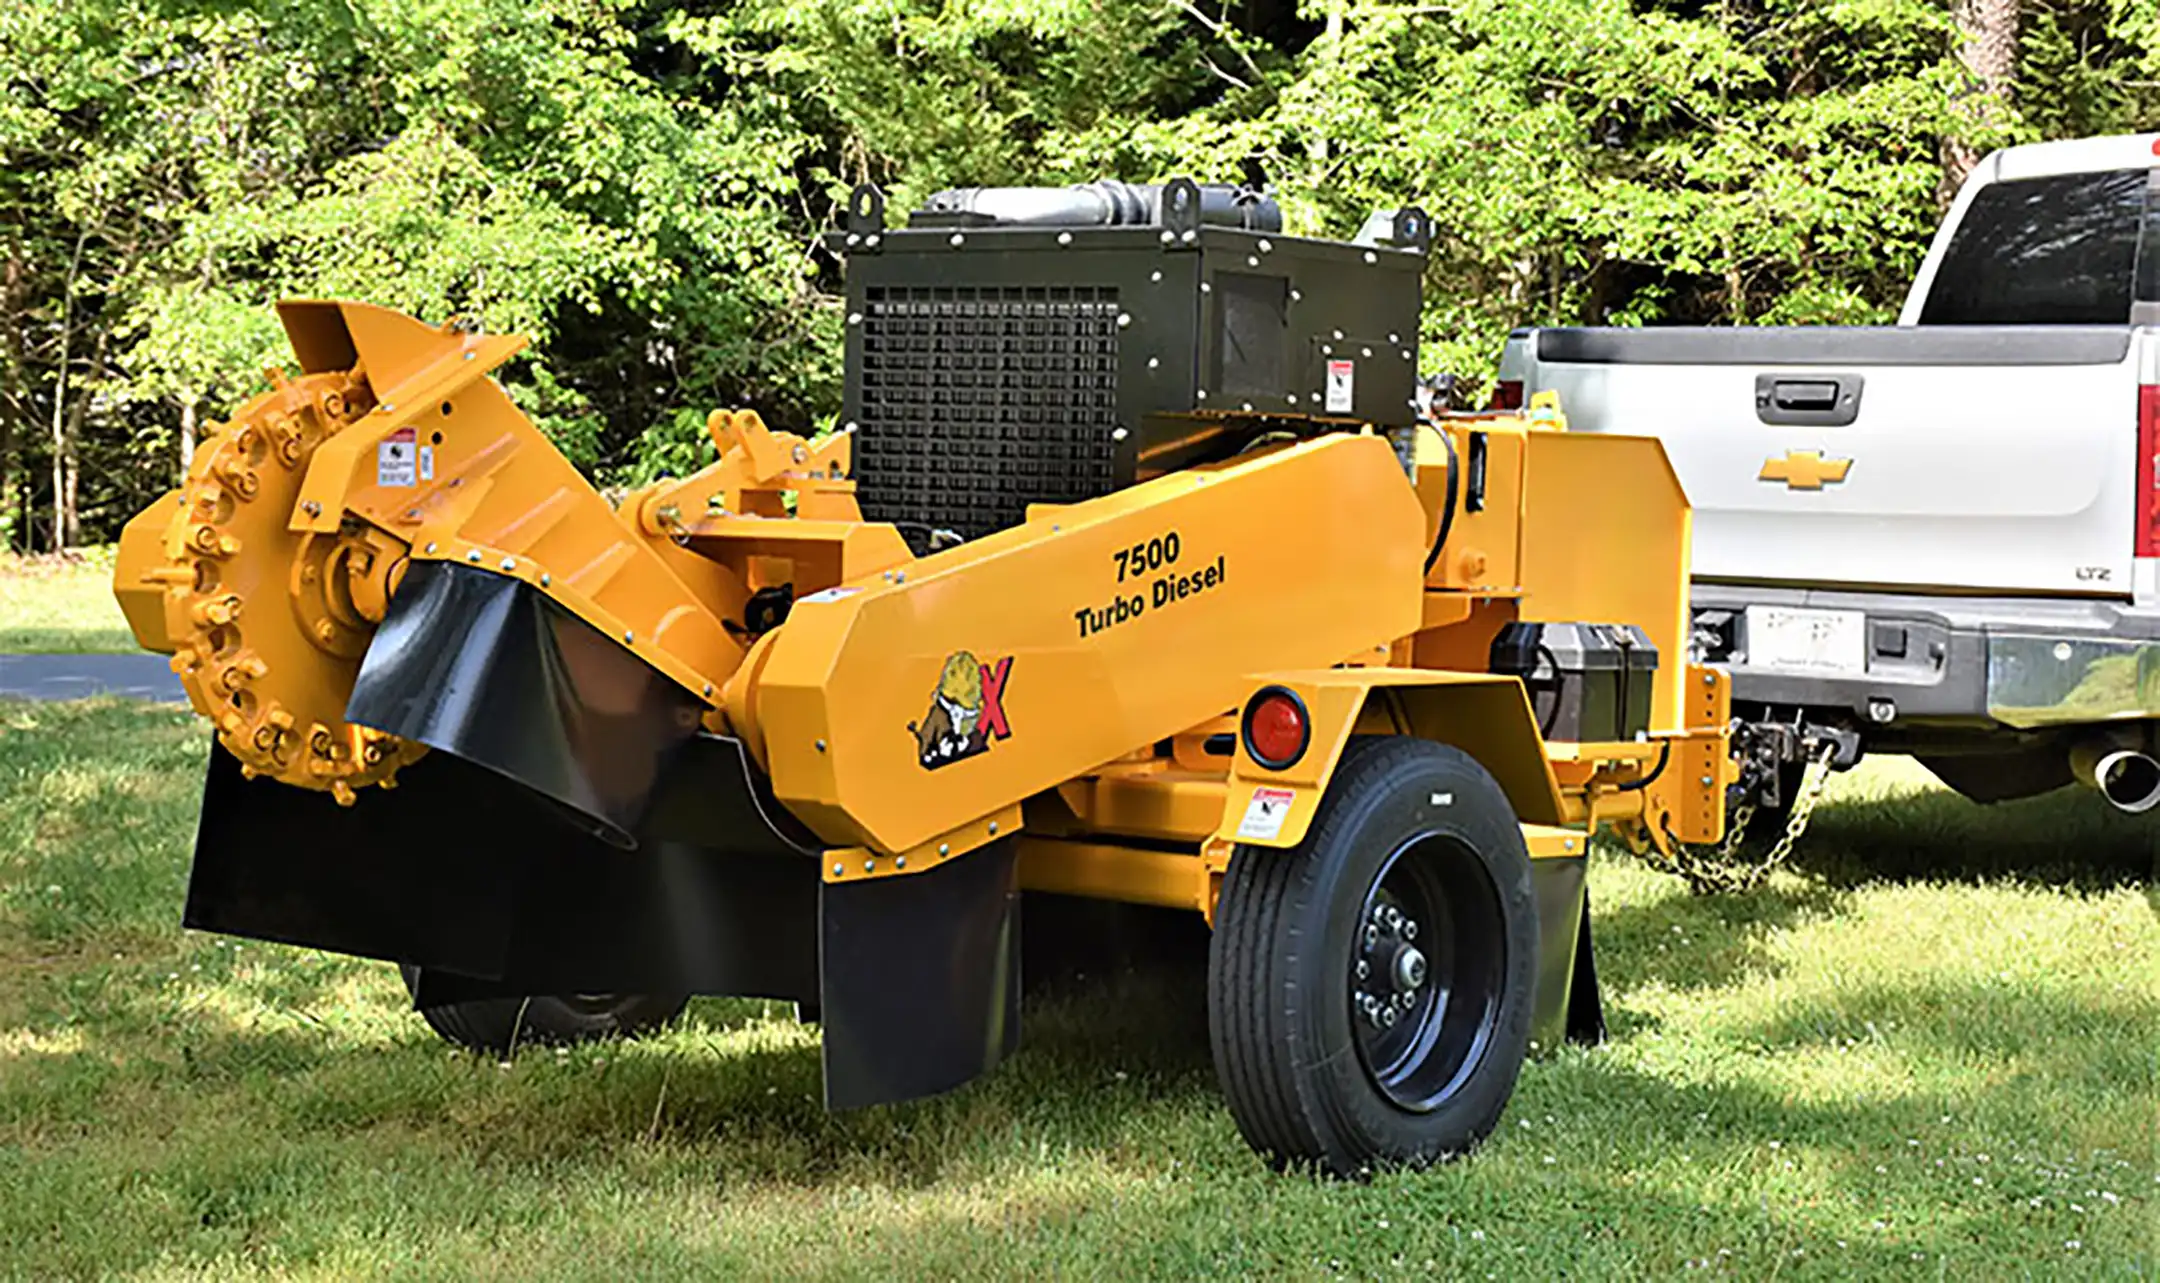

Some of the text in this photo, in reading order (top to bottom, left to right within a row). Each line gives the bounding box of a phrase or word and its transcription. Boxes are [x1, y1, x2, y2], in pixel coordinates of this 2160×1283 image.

[1113, 532, 1180, 583] 7500
[2075, 566, 2112, 582] LTZ
[1075, 555, 1225, 638] Turbo Diesel
